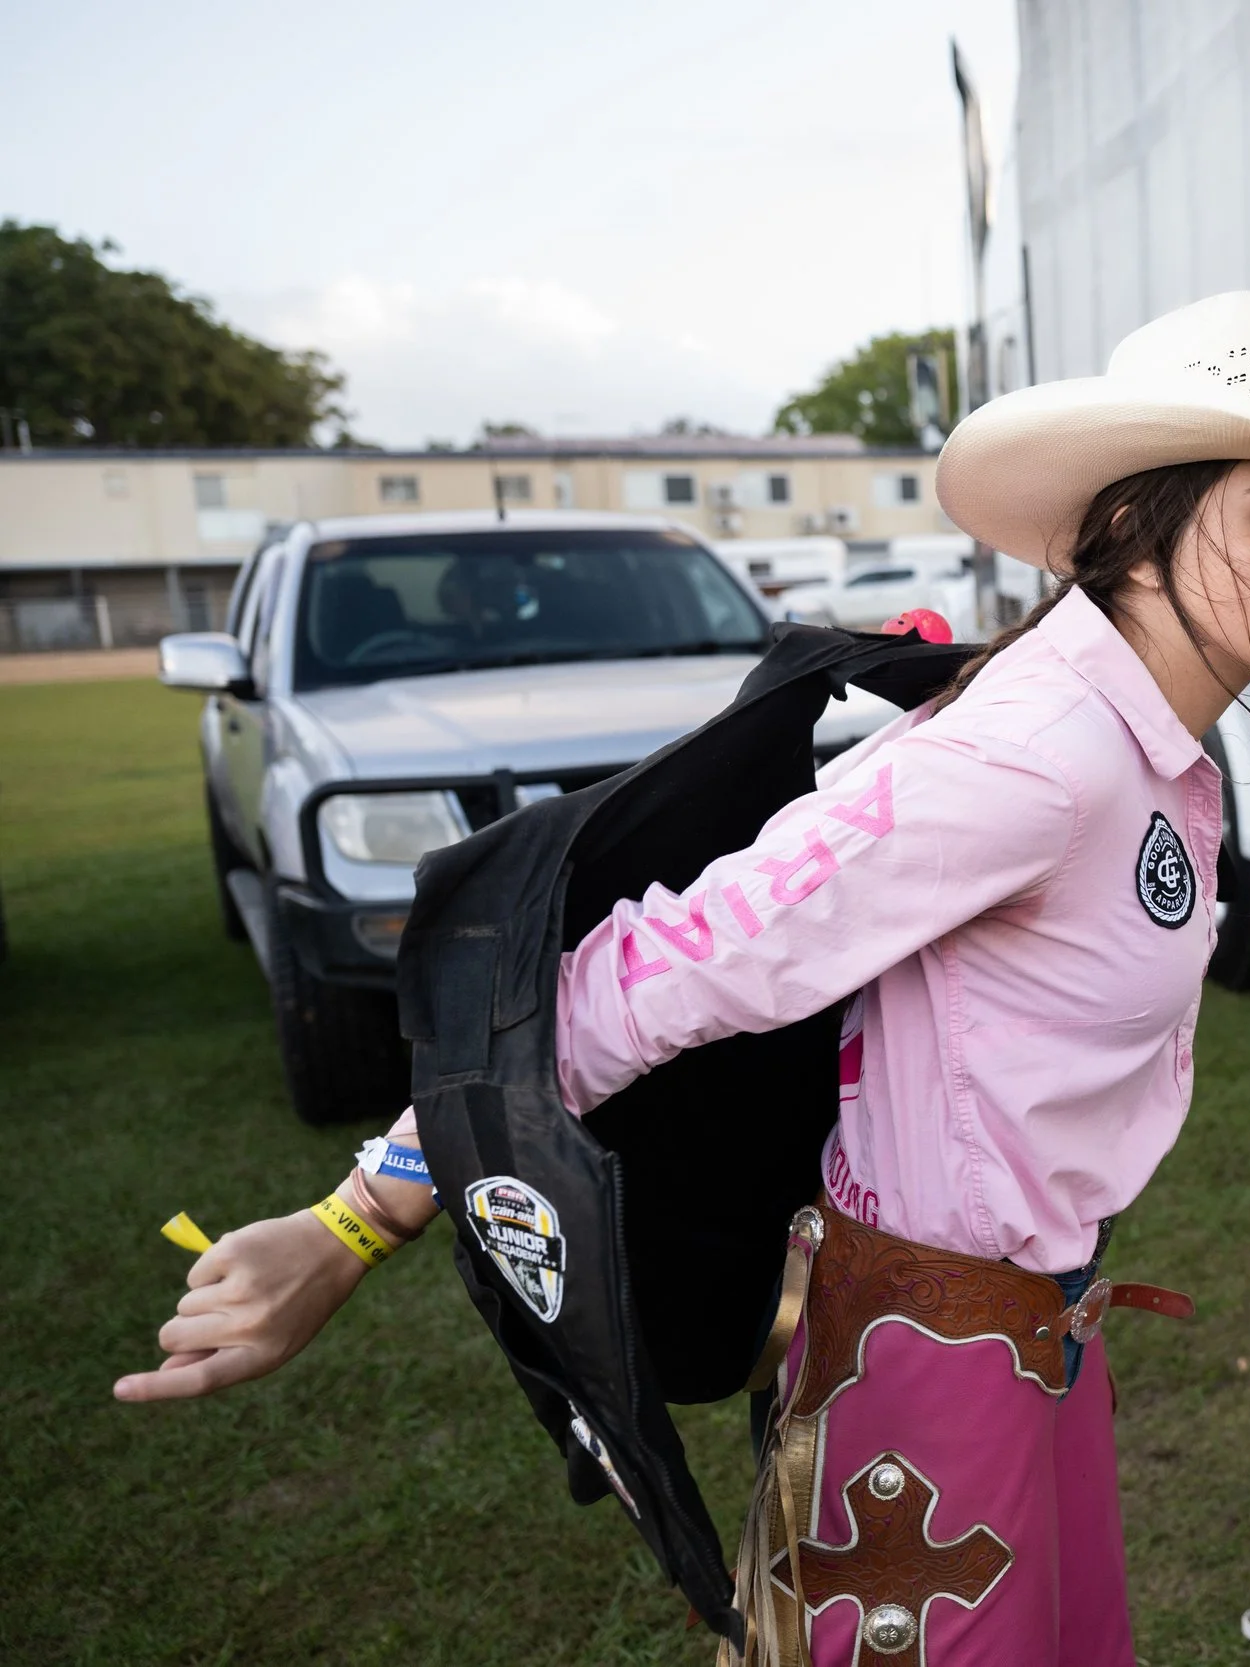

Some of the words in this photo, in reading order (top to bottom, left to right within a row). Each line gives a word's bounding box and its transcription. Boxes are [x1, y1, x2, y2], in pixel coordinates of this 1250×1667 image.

[618, 762, 894, 992] ARIAT
[1156, 891, 1185, 910] APPAREL
[383, 1153, 429, 1173] PETIT
[338, 1213, 360, 1233] VIP
[358, 1234, 374, 1250] w/
[487, 1223, 549, 1255] JUNIOR
[497, 1242, 543, 1265] ACADEMY
